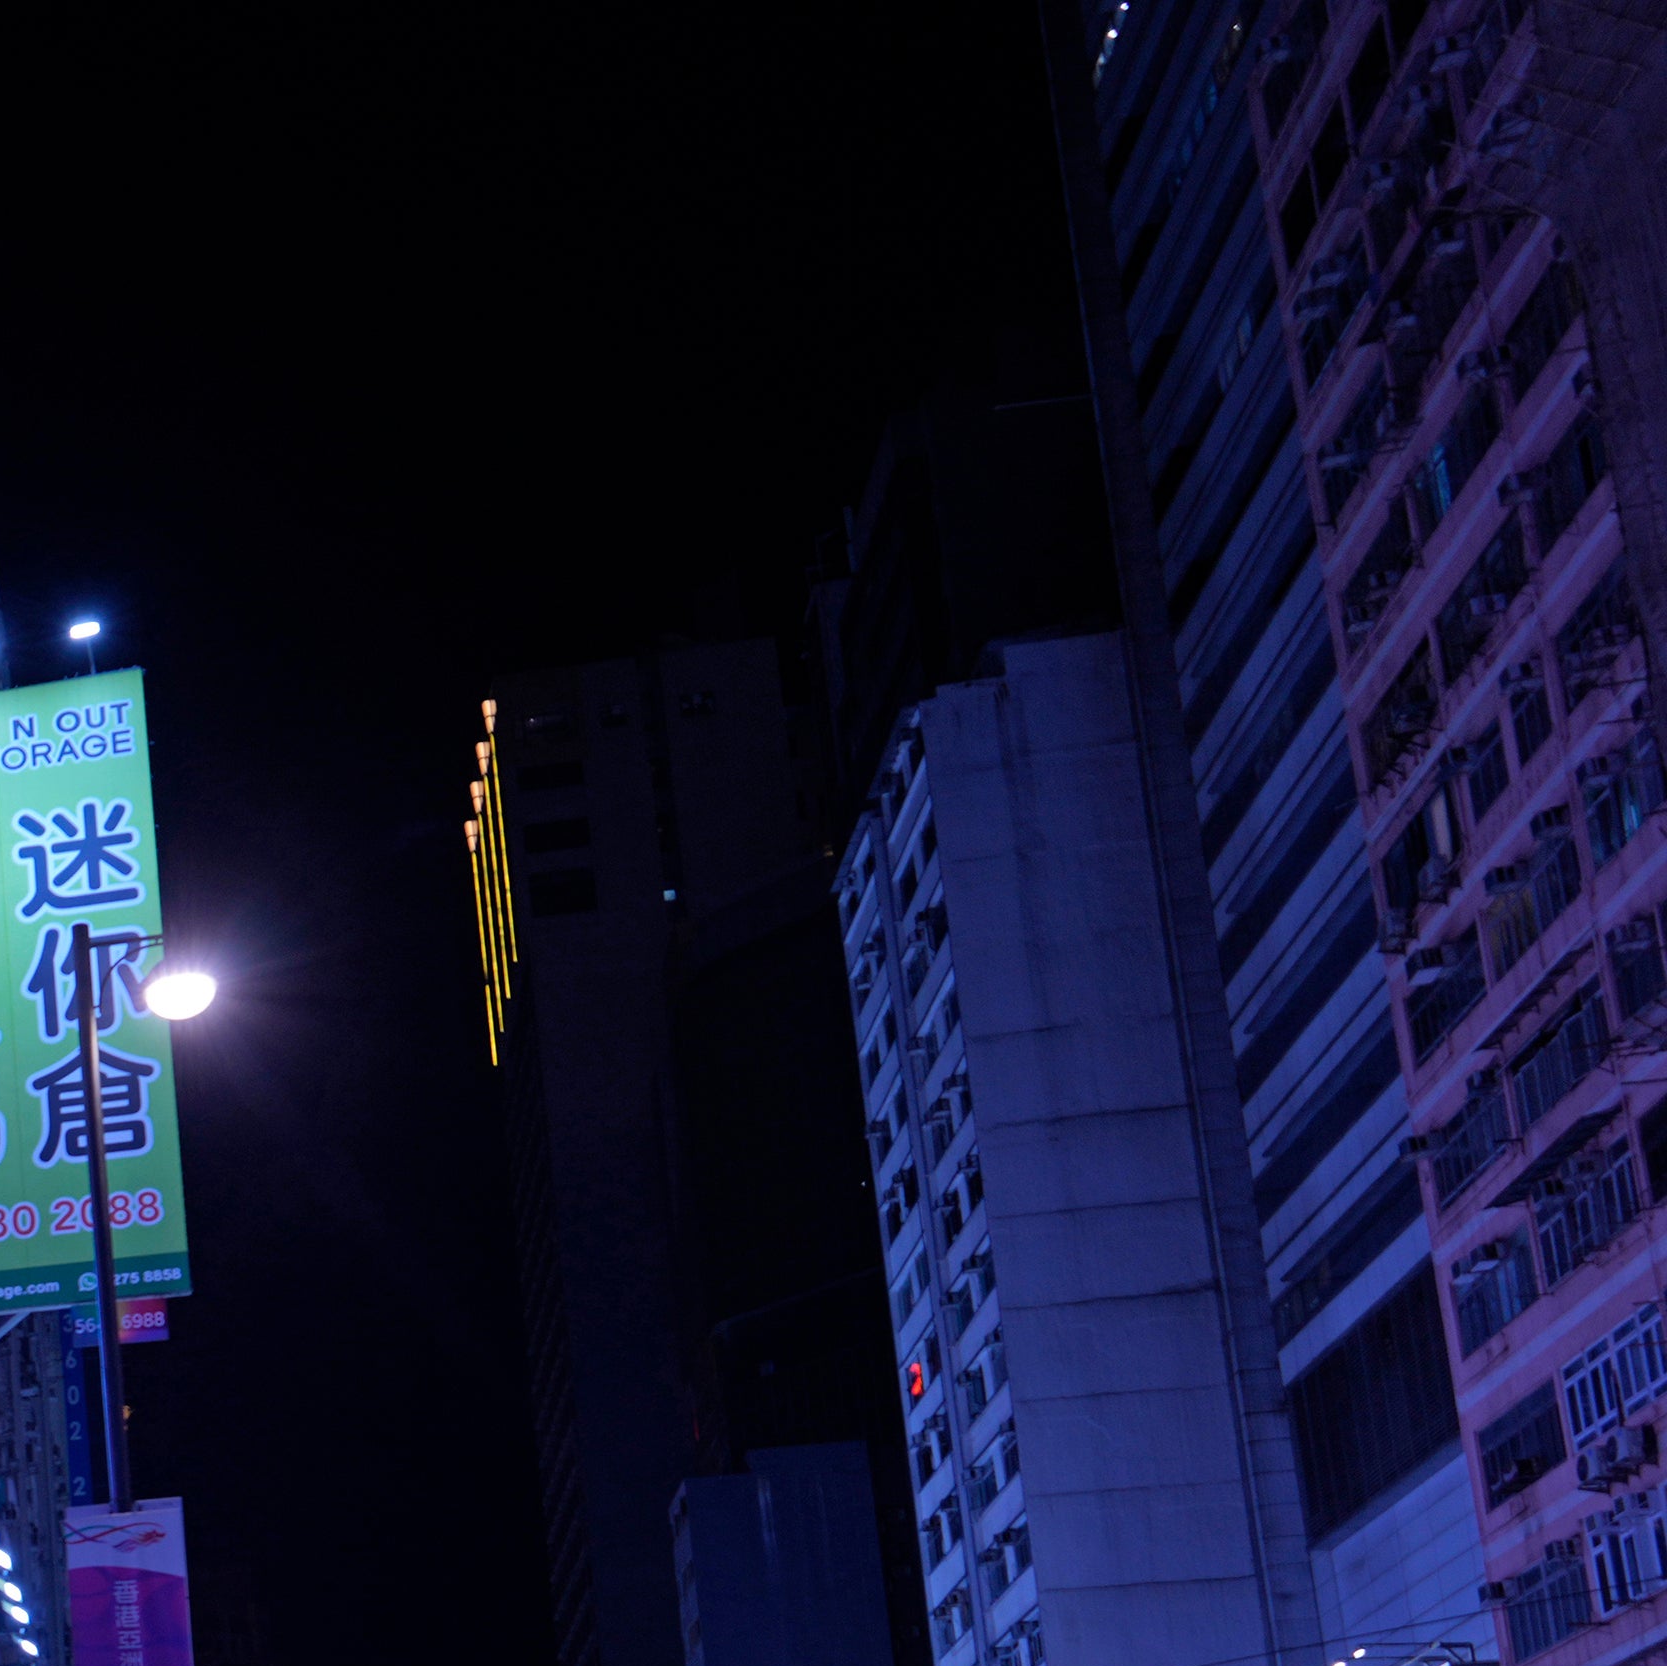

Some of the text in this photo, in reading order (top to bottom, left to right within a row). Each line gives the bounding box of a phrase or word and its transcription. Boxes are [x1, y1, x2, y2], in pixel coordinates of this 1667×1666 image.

[13, 716, 36, 741] N
[56, 702, 131, 733] OUT
[18, 802, 154, 1163] 迷你倉
[143, 1266, 182, 1283] 8858
[121, 1311, 166, 1330] 6988
